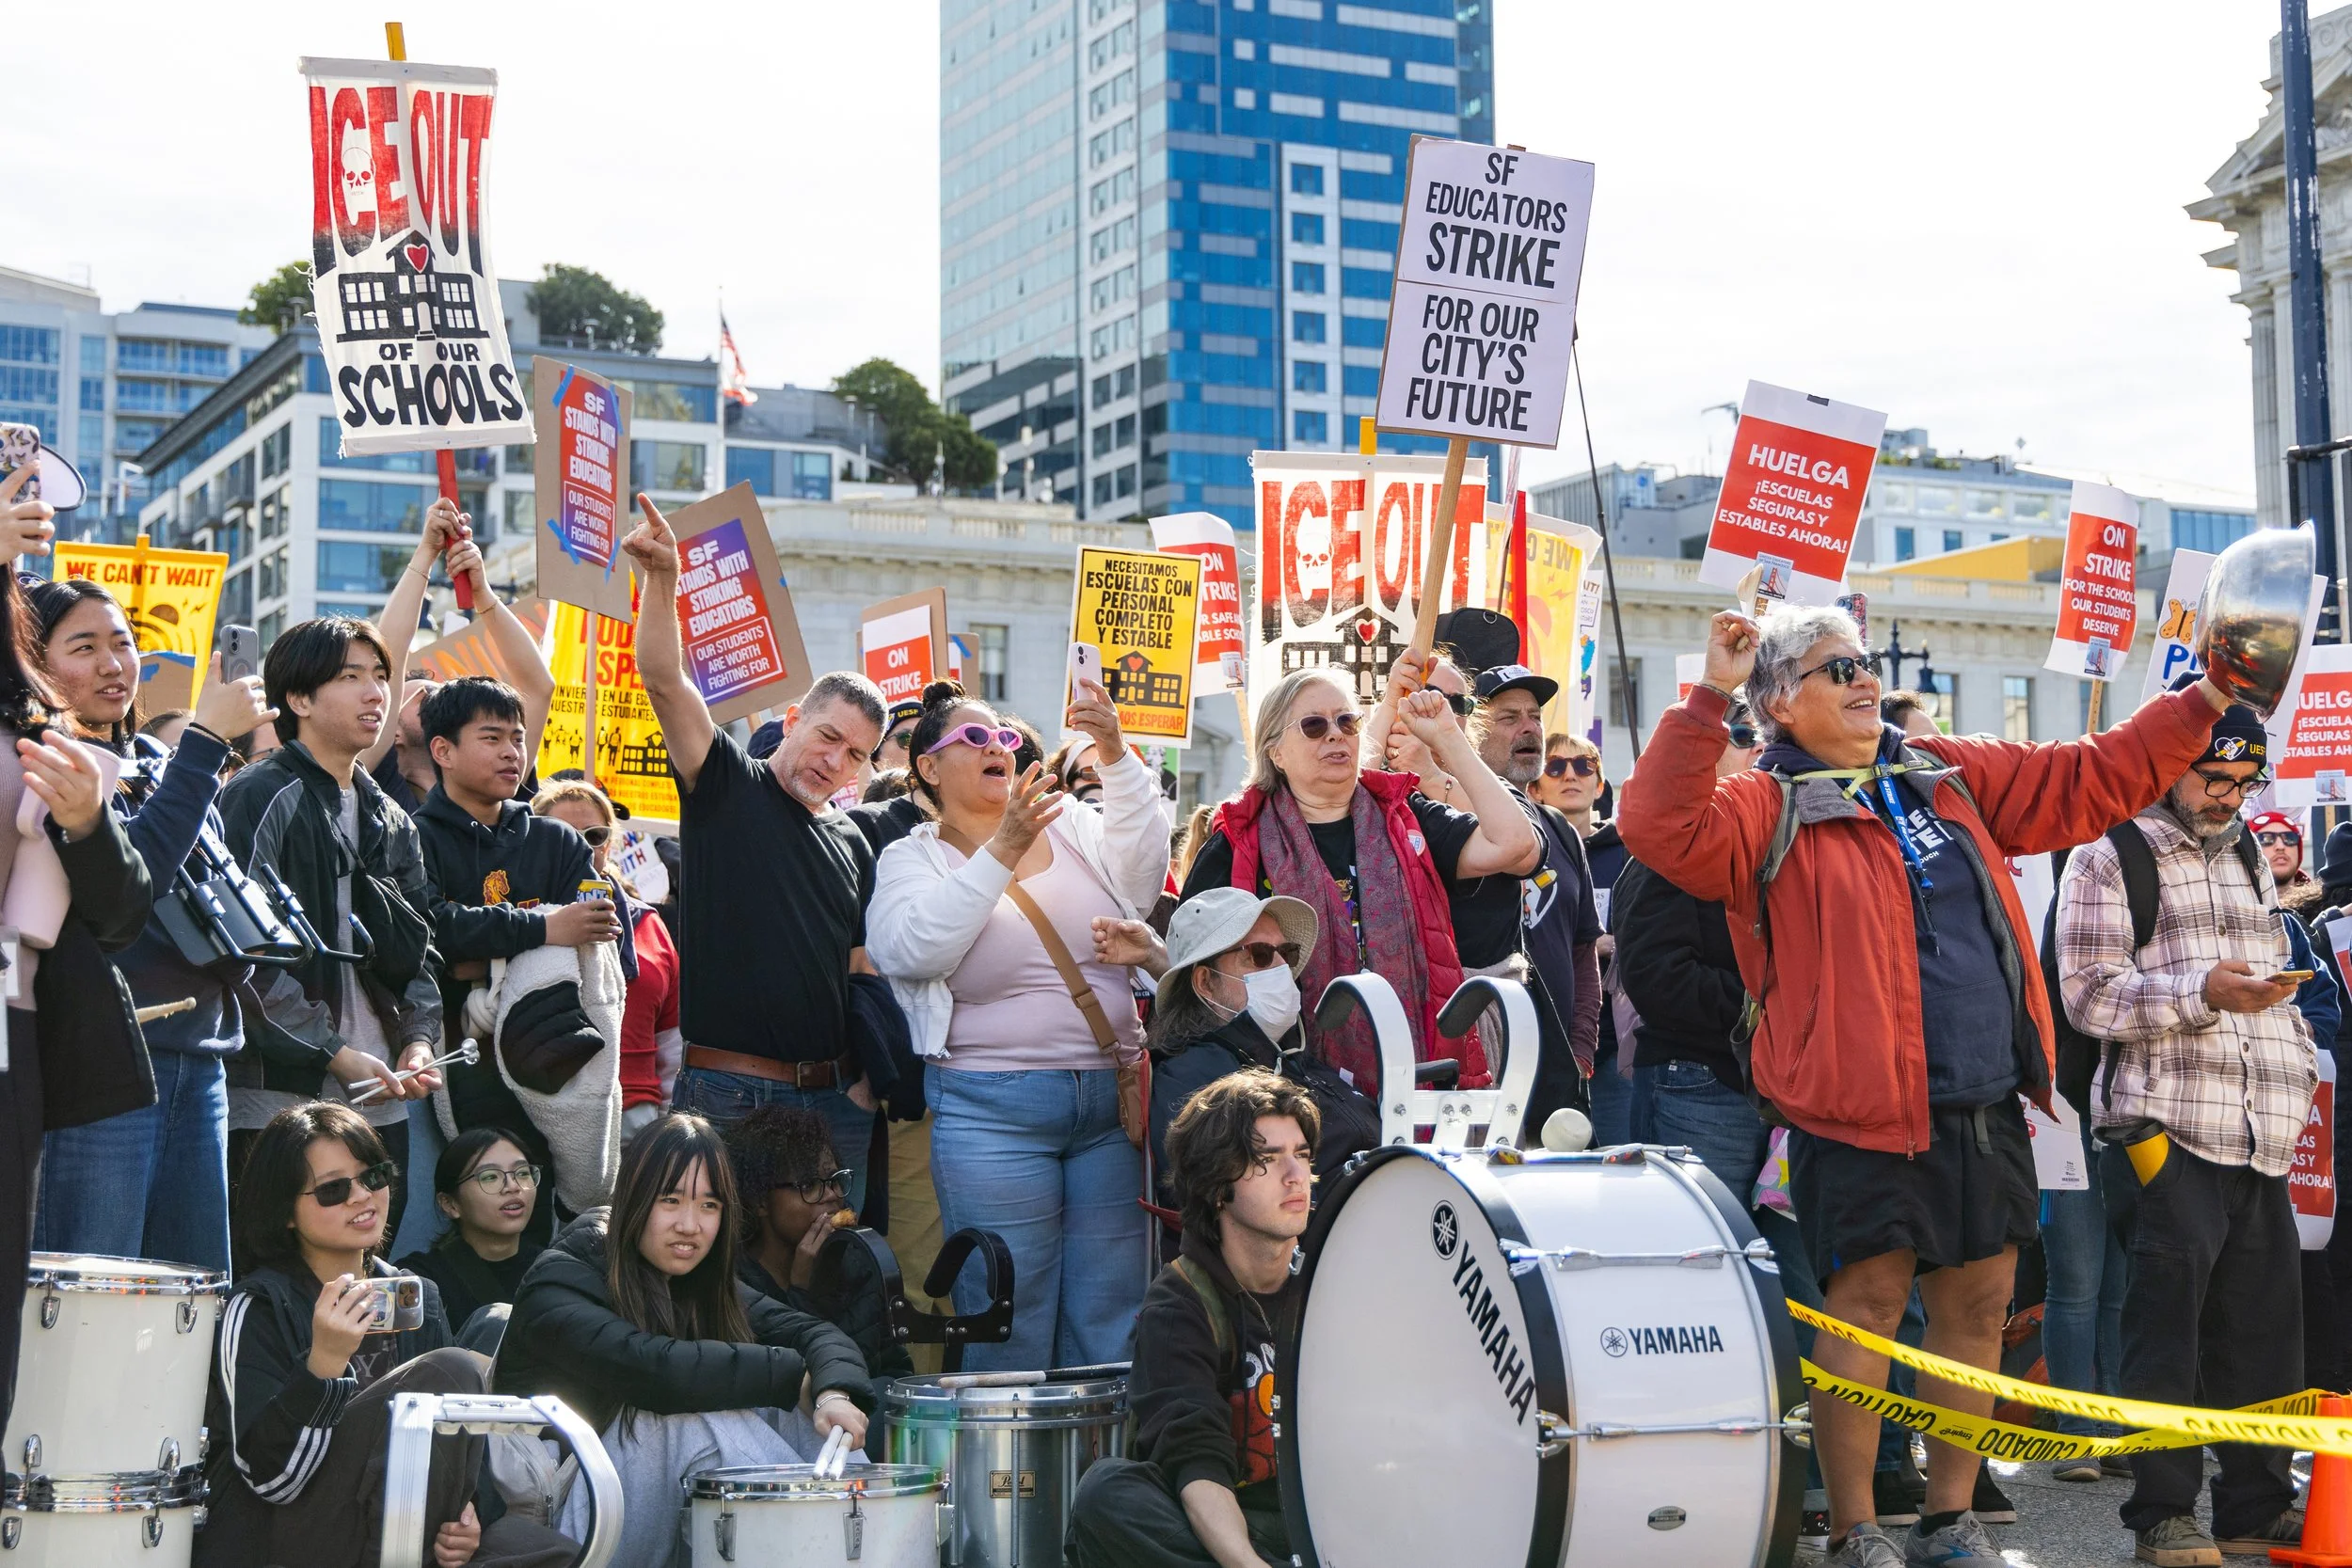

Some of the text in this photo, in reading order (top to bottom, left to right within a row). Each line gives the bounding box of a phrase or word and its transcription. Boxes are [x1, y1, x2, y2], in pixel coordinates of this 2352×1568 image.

[310, 86, 495, 279] ICE OUT
[1484, 151, 1519, 186] SF
[1425, 181, 1568, 234] EDUCATORS
[1425, 221, 1561, 289] STRIKE
[1422, 293, 1539, 343] FOR OUR
[378, 342, 481, 361] OF OUR
[1422, 332, 1528, 385] CITY'S
[338, 362, 523, 428] SCHOOLS
[583, 391, 606, 416] SF
[1406, 376, 1533, 433] FUTURE
[564, 405, 616, 450] STANDS WITH
[575, 433, 610, 468] STRIKING
[569, 454, 612, 495] EDUCATORS
[1747, 443, 1850, 490] HUELGA
[568, 489, 612, 521] OUR STUDENTS
[1755, 480, 1834, 510] ¡ESCUELAS
[573, 509, 609, 536] ARE WORTH
[1746, 497, 1830, 528] SEGURAS Y
[570, 525, 610, 554] FIGHTING FOR
[1717, 508, 1849, 554] ESTABLES AHORA!
[2103, 525, 2126, 548] ON
[687, 539, 720, 567] SF
[1203, 552, 1225, 572] ON
[1262, 479, 1486, 648] ICE OUT
[2084, 552, 2132, 582] STRIKE
[67, 562, 215, 587] WE CAN'T WAIT
[676, 549, 750, 597] STANDS WITH
[1104, 559, 1178, 578] NECESITAMOS
[690, 576, 744, 614] STRIKING
[1086, 571, 1192, 597] ESCUELAS CON
[1202, 580, 1238, 602] TRIKE
[2063, 578, 2137, 606] FOR THE SCHOOLS
[688, 594, 756, 638] EDUCATORS
[1101, 591, 1175, 613] PERSONAL
[2071, 597, 2131, 622] OUR STUDENTS
[1094, 608, 1173, 631] COMPLETO
[1211, 611, 1234, 626] SAFE
[2082, 617, 2120, 636] DESERVE
[695, 625, 765, 661] OUR STUDENTS
[1097, 626, 1173, 649] Y ESTABLE
[1198, 628, 1222, 643] ABLE
[707, 643, 761, 674] ARE WORTH
[887, 646, 909, 669] ON
[707, 657, 771, 690] FIGHTING FOR
[879, 671, 922, 697] STRIKE
[603, 689, 615, 704] EN
[618, 690, 632, 705] LAS
[2297, 690, 2352, 710] UELG
[897, 708, 918, 719] UESF
[1138, 712, 1184, 731] ESPERAR
[2297, 715, 2352, 731] ¡ESCUELA
[2296, 730, 2350, 743] SEGURAS
[2284, 744, 2332, 758] STABLES
[2288, 1174, 2333, 1190] AHORA!
[1452, 1239, 1536, 1427] YAMAHA
[1628, 1324, 1724, 1355] YAMAHA
[1976, 1427, 2076, 1461] CUIDADO
